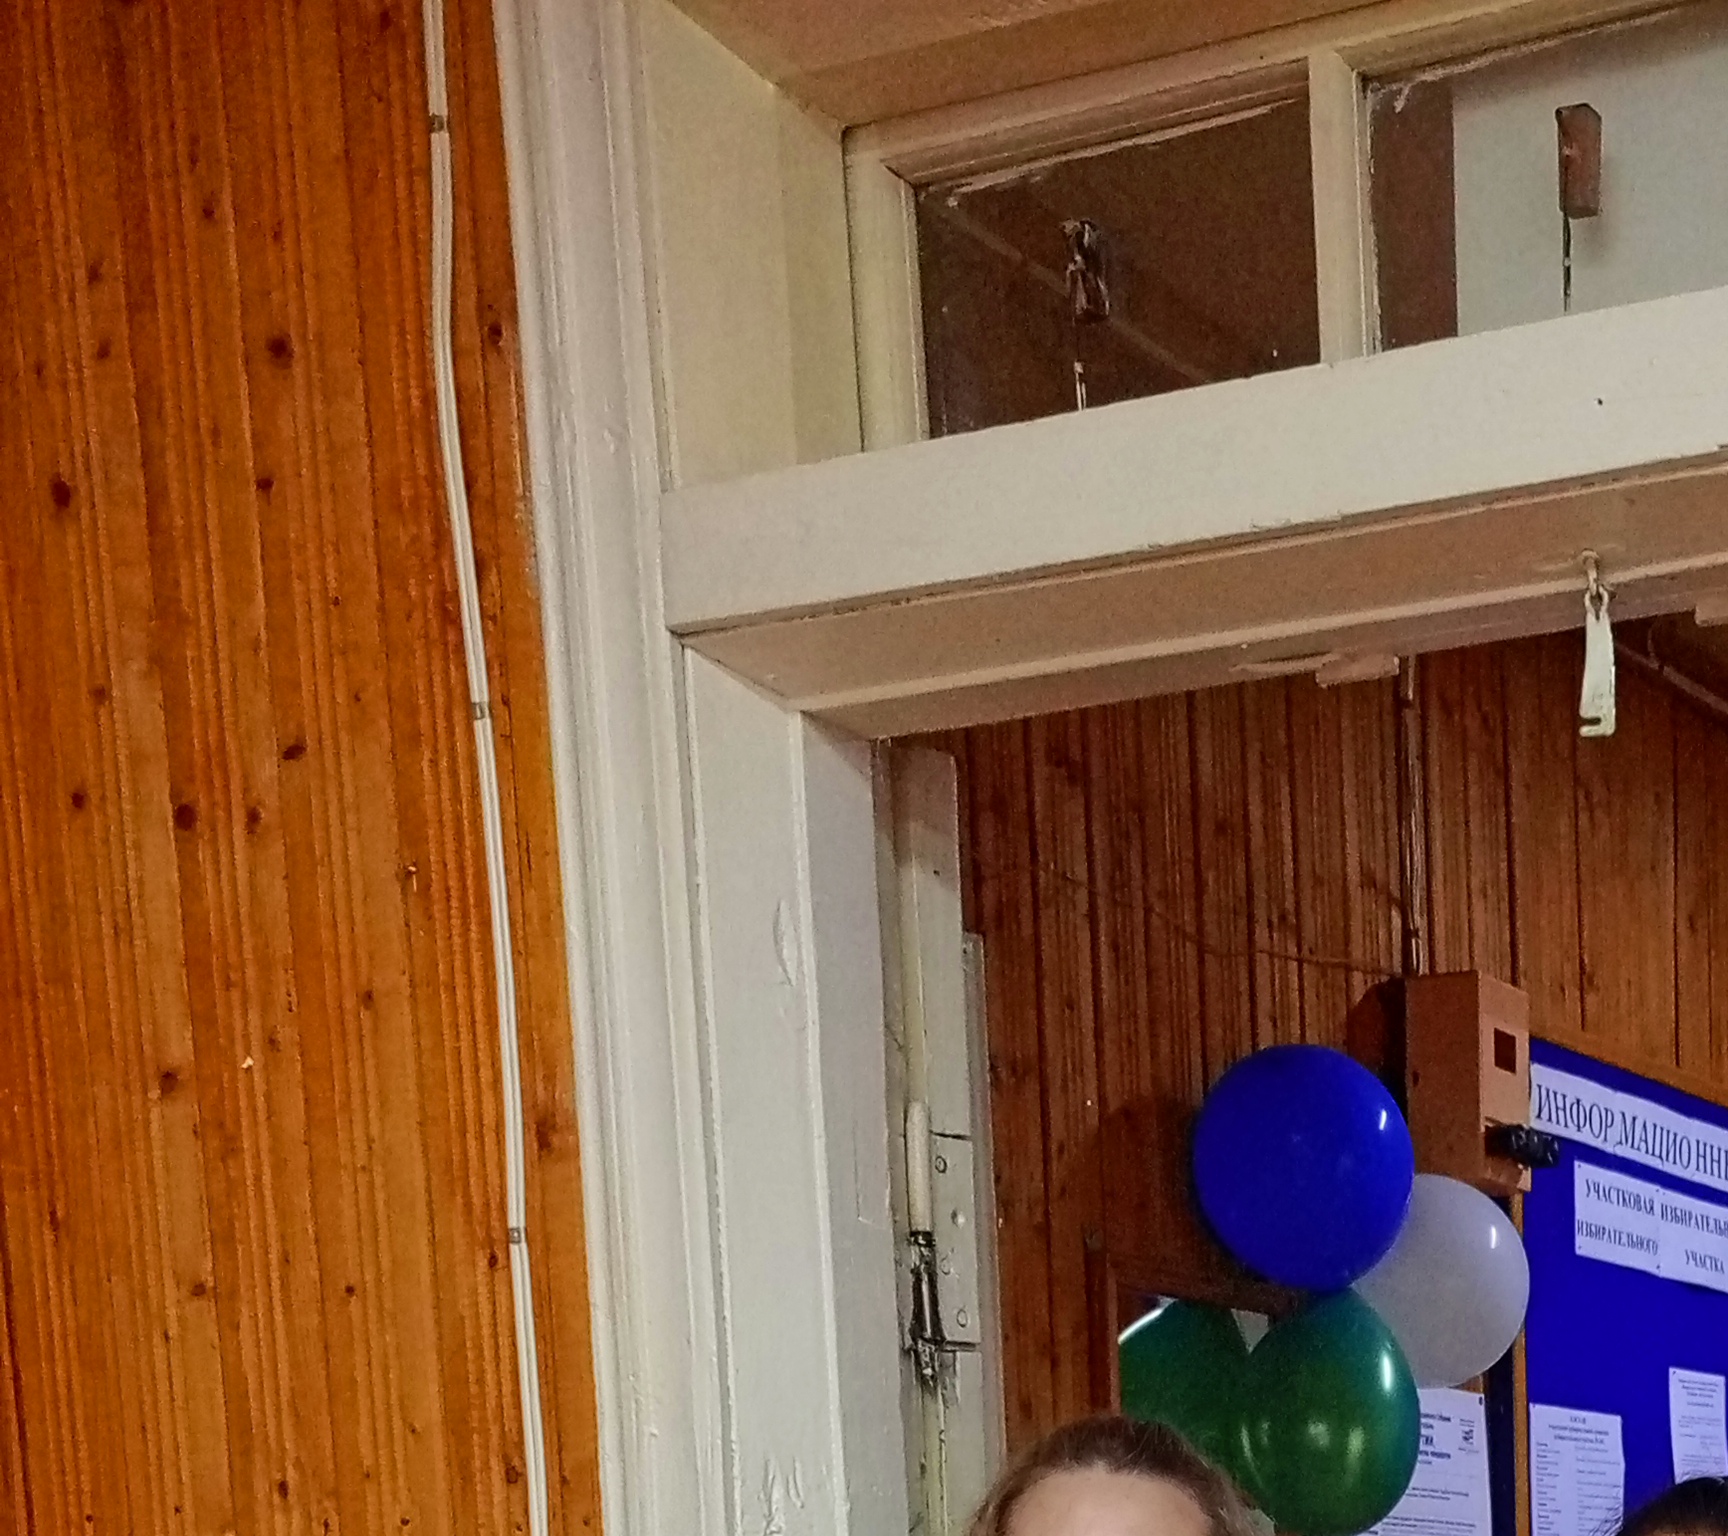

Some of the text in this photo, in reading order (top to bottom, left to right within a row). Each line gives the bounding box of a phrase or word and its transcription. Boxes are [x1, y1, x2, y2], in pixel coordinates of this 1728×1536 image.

[1585, 1178, 1655, 1216] УЧАСТКОВАЯ
[1576, 1219, 1658, 1256] ИЗБИРАТЕЛЬНОГО
[1685, 1249, 1725, 1275] УЧАСТКА
